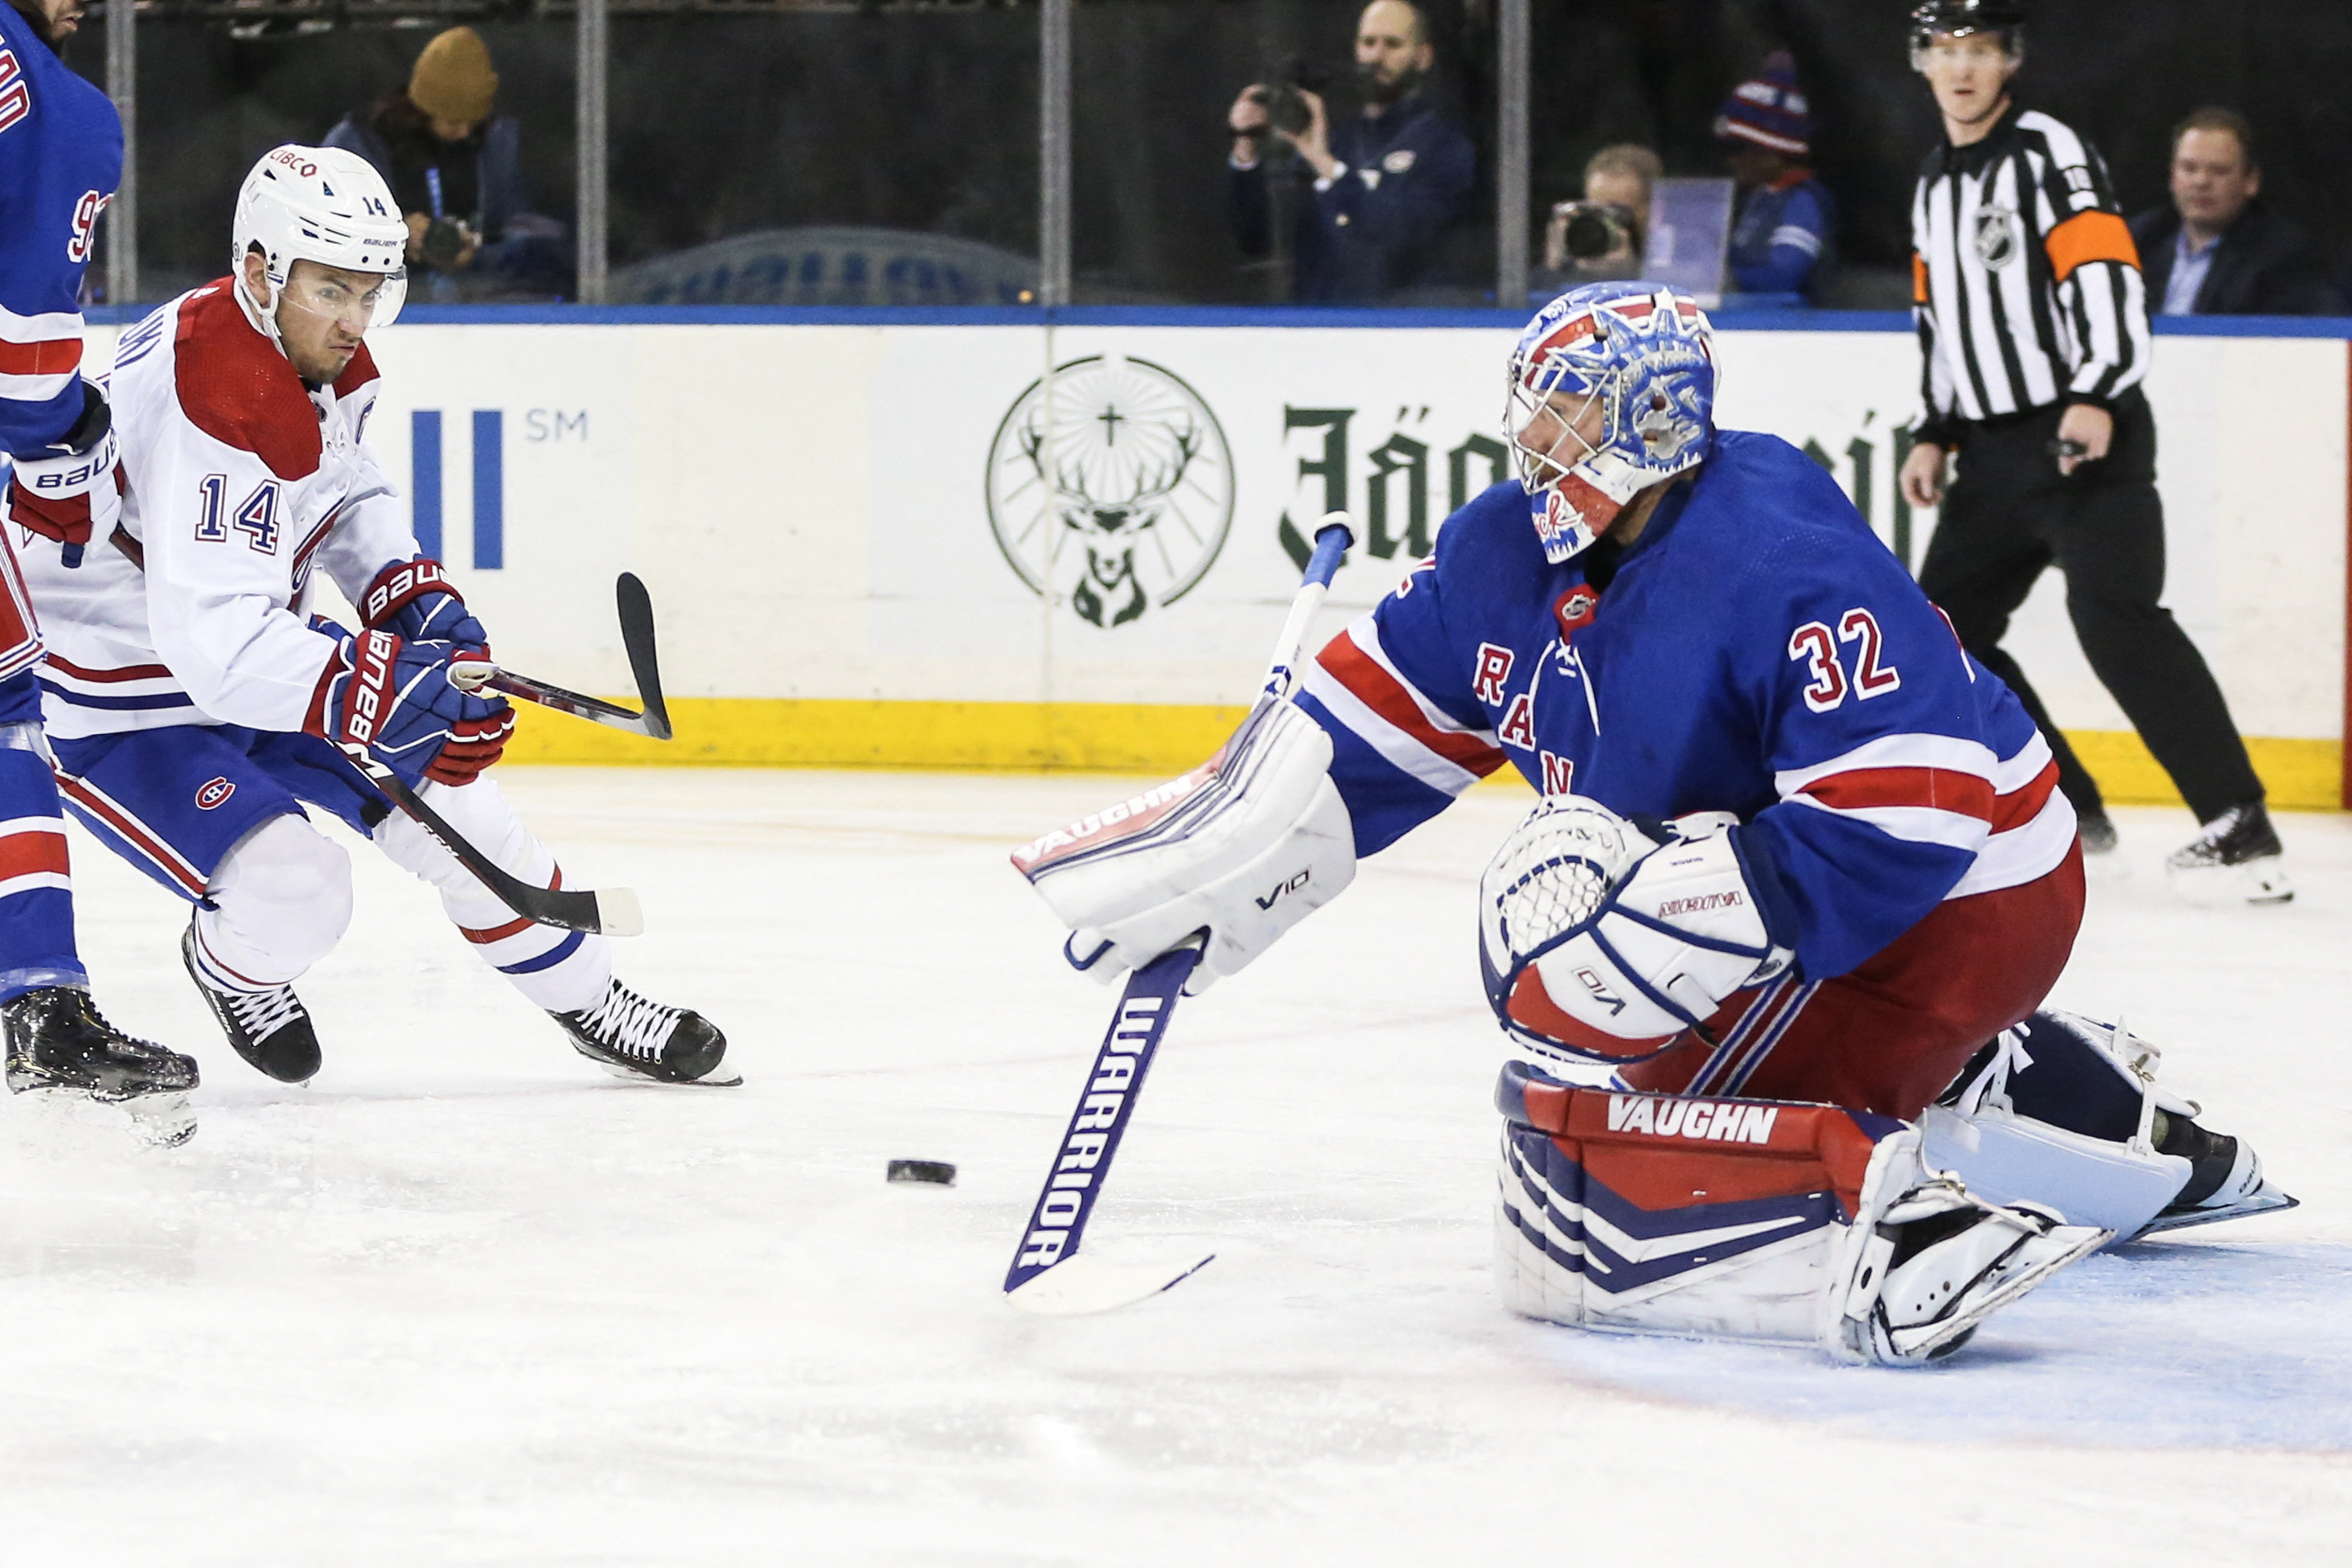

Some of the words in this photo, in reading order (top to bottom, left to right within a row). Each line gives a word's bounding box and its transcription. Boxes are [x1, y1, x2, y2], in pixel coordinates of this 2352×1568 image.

[363, 196, 388, 217] 14
[527, 408, 588, 441] SM
[195, 474, 281, 556] 14
[1788, 607, 1901, 713] 32
[1017, 996, 1163, 1269] WARRIOR
[1608, 1094, 1779, 1145] VAUGHN
